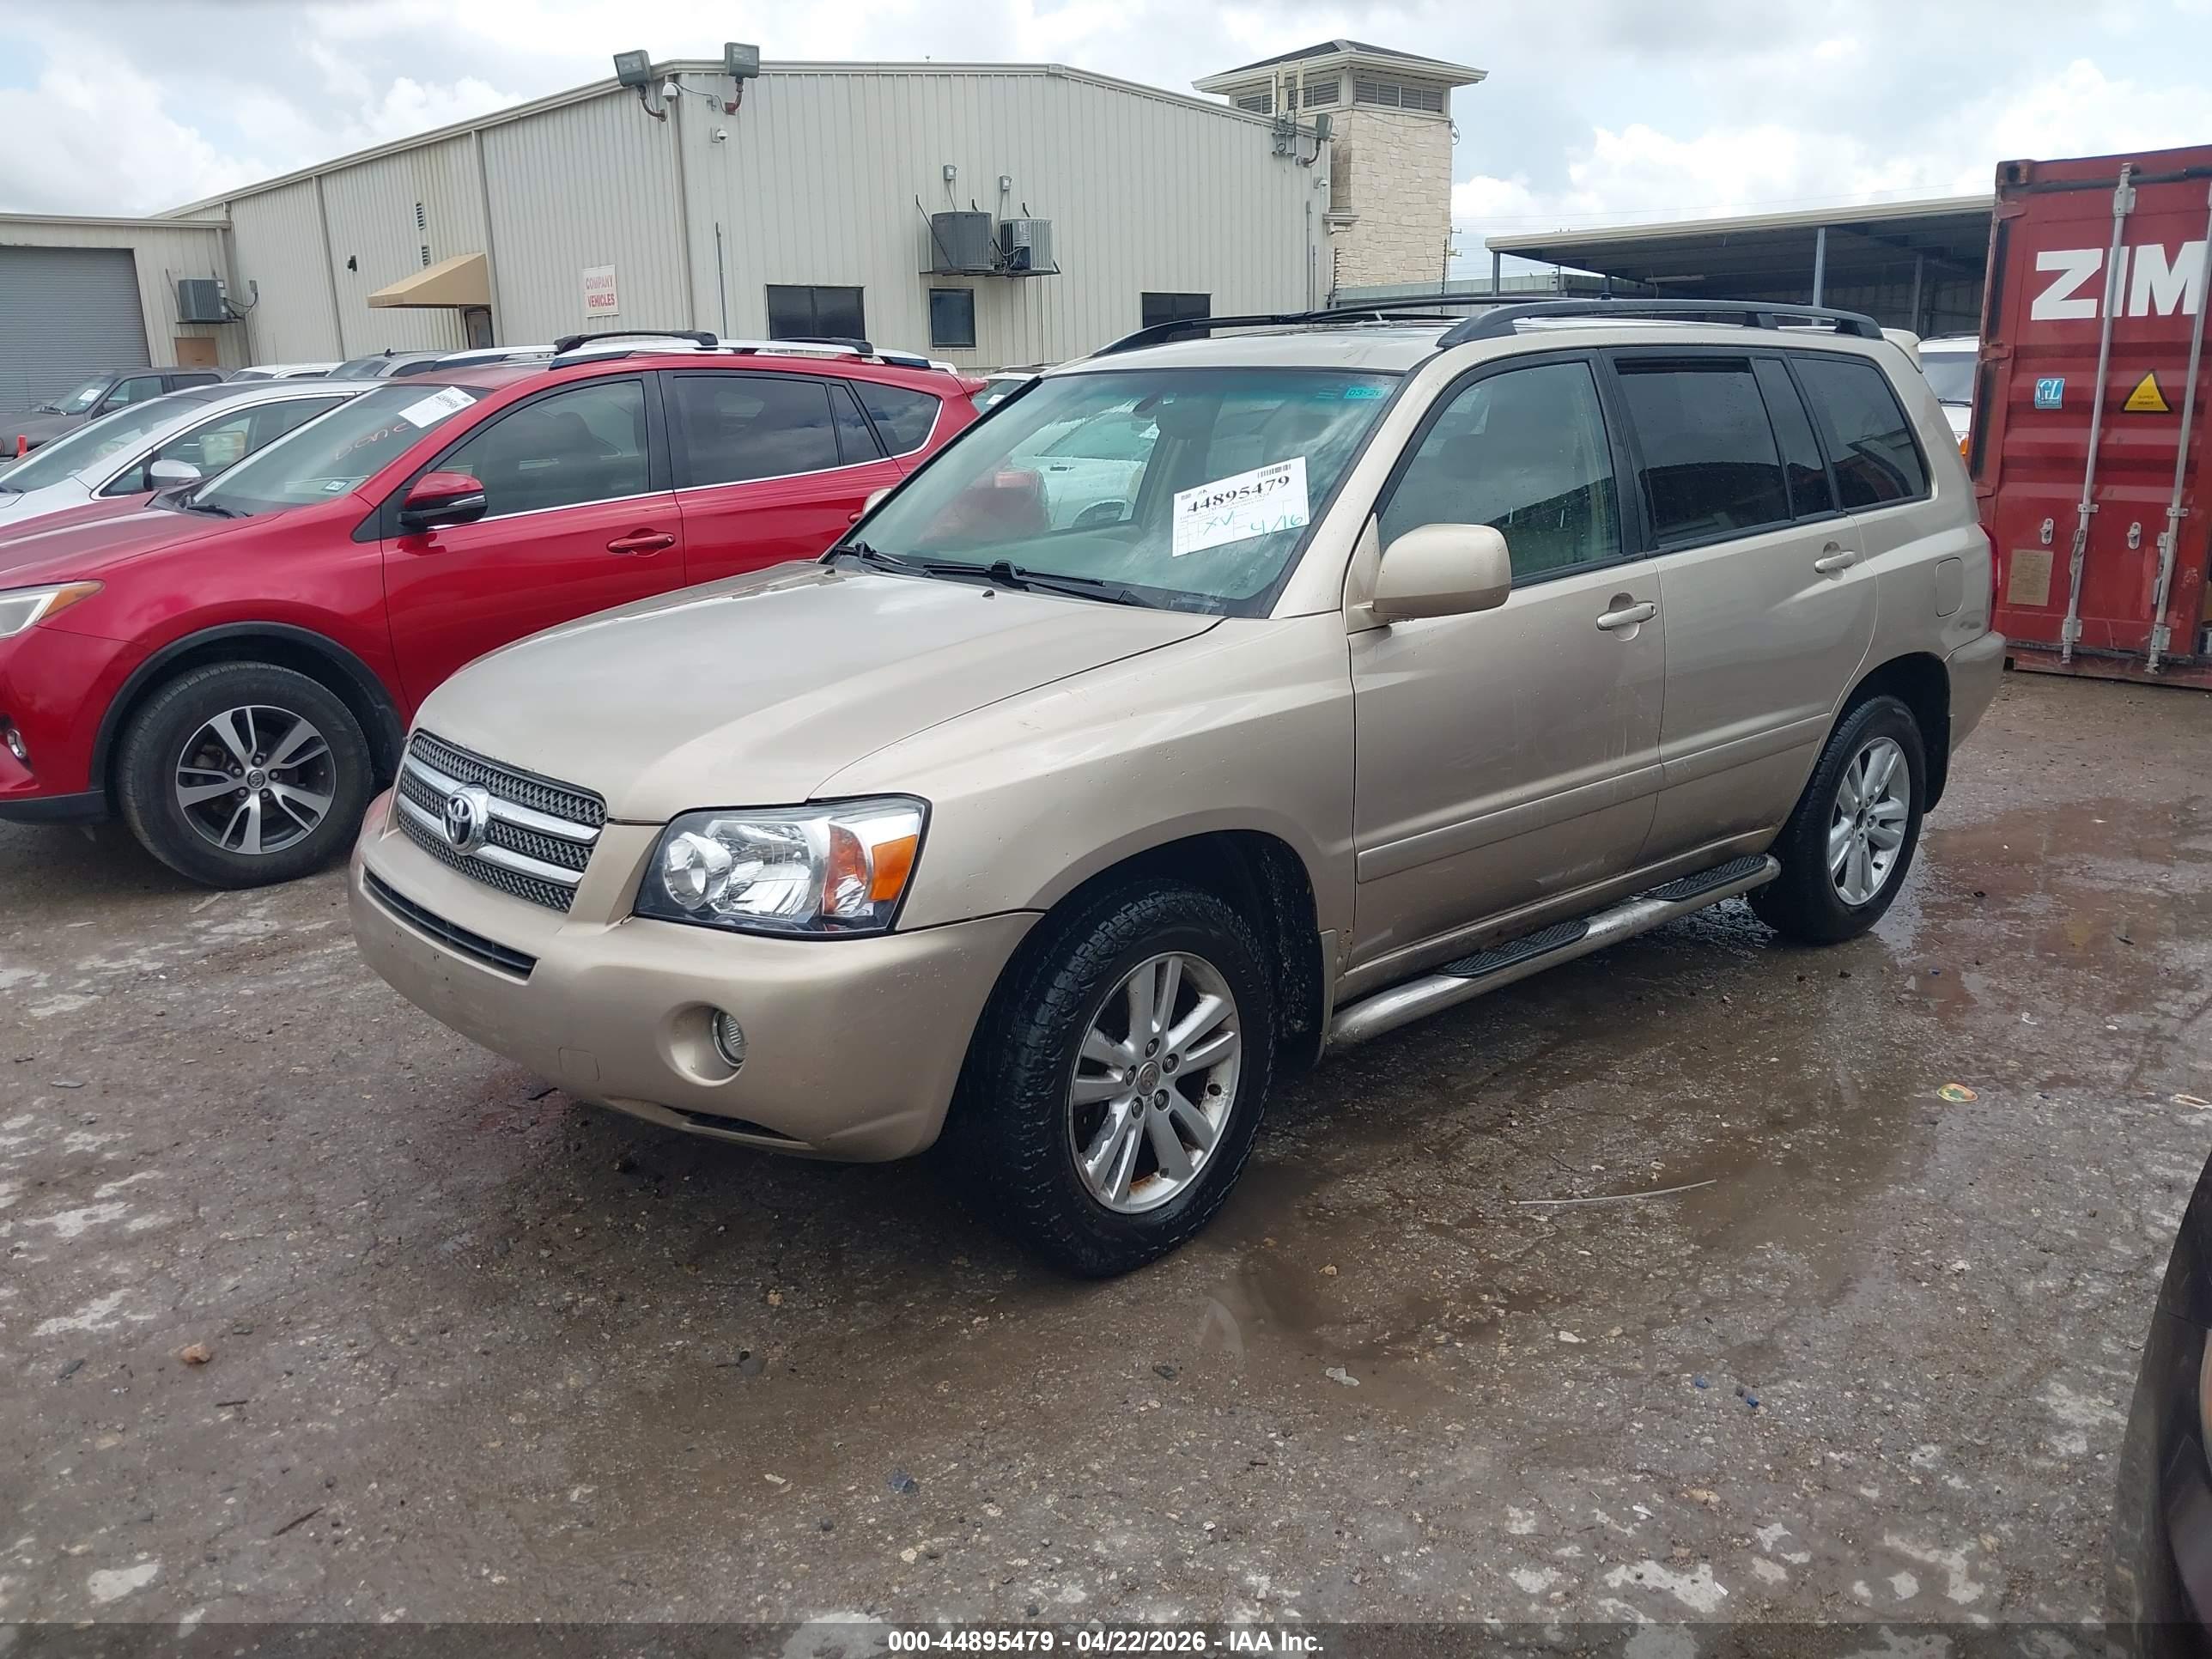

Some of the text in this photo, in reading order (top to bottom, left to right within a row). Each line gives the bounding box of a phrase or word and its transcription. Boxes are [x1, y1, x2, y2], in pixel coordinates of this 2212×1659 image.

[586, 275, 613, 289] COMPANY
[2031, 240, 2208, 320] ZIM
[587, 294, 615, 307] VEHICLES
[1187, 475, 1291, 514] 44895479
